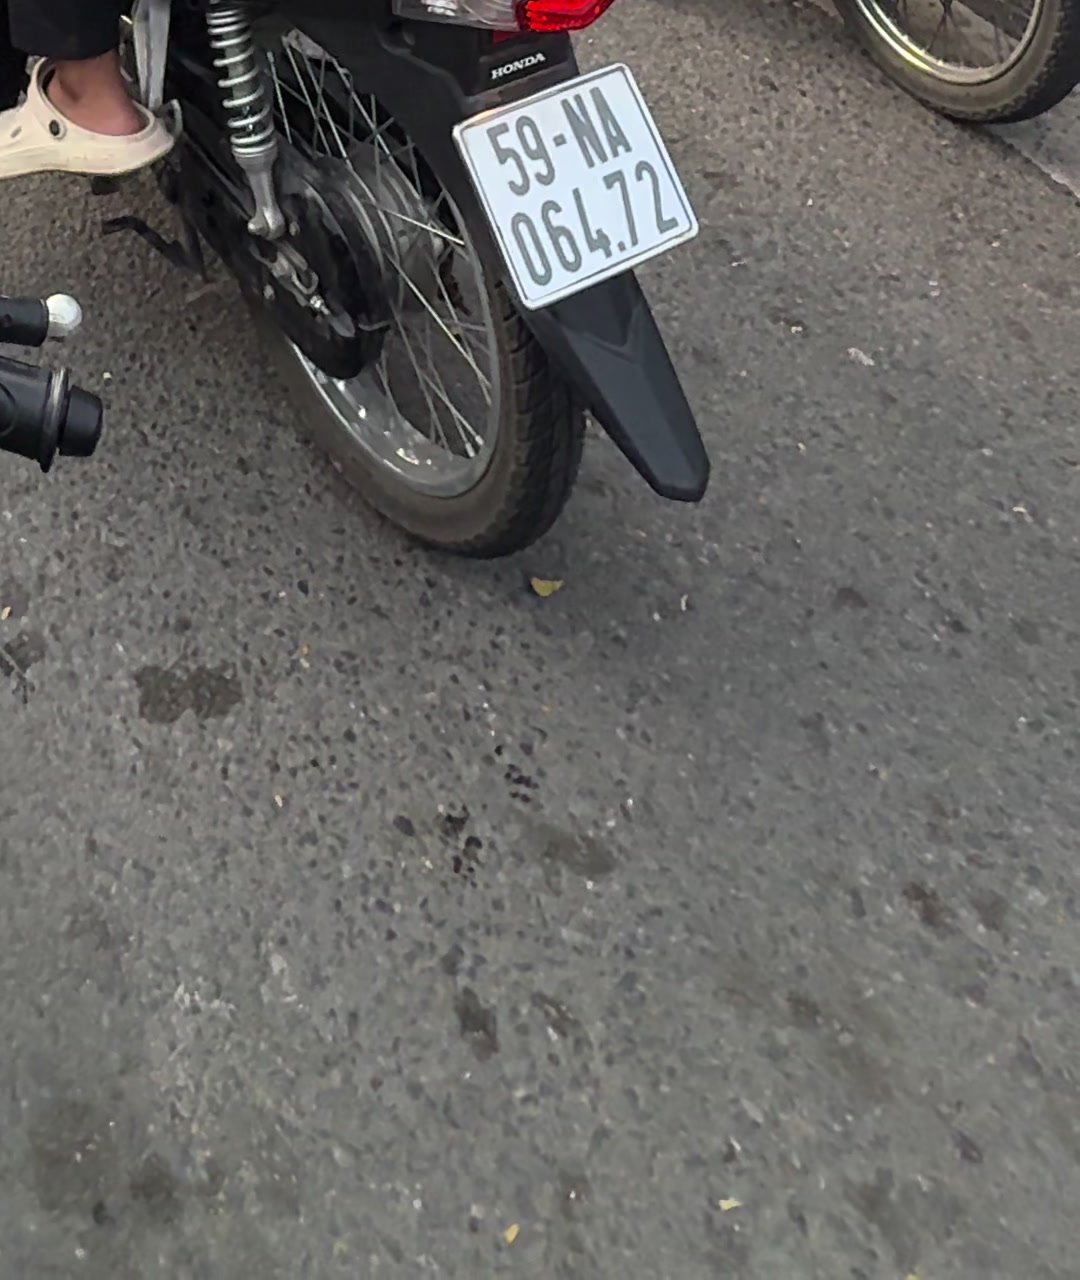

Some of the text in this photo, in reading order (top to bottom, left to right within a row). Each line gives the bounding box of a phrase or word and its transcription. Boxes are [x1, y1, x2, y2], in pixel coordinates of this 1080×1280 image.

[491, 52, 546, 80] HONDA
[486, 87, 633, 197] 59-NA
[510, 160, 679, 286] 064.72
